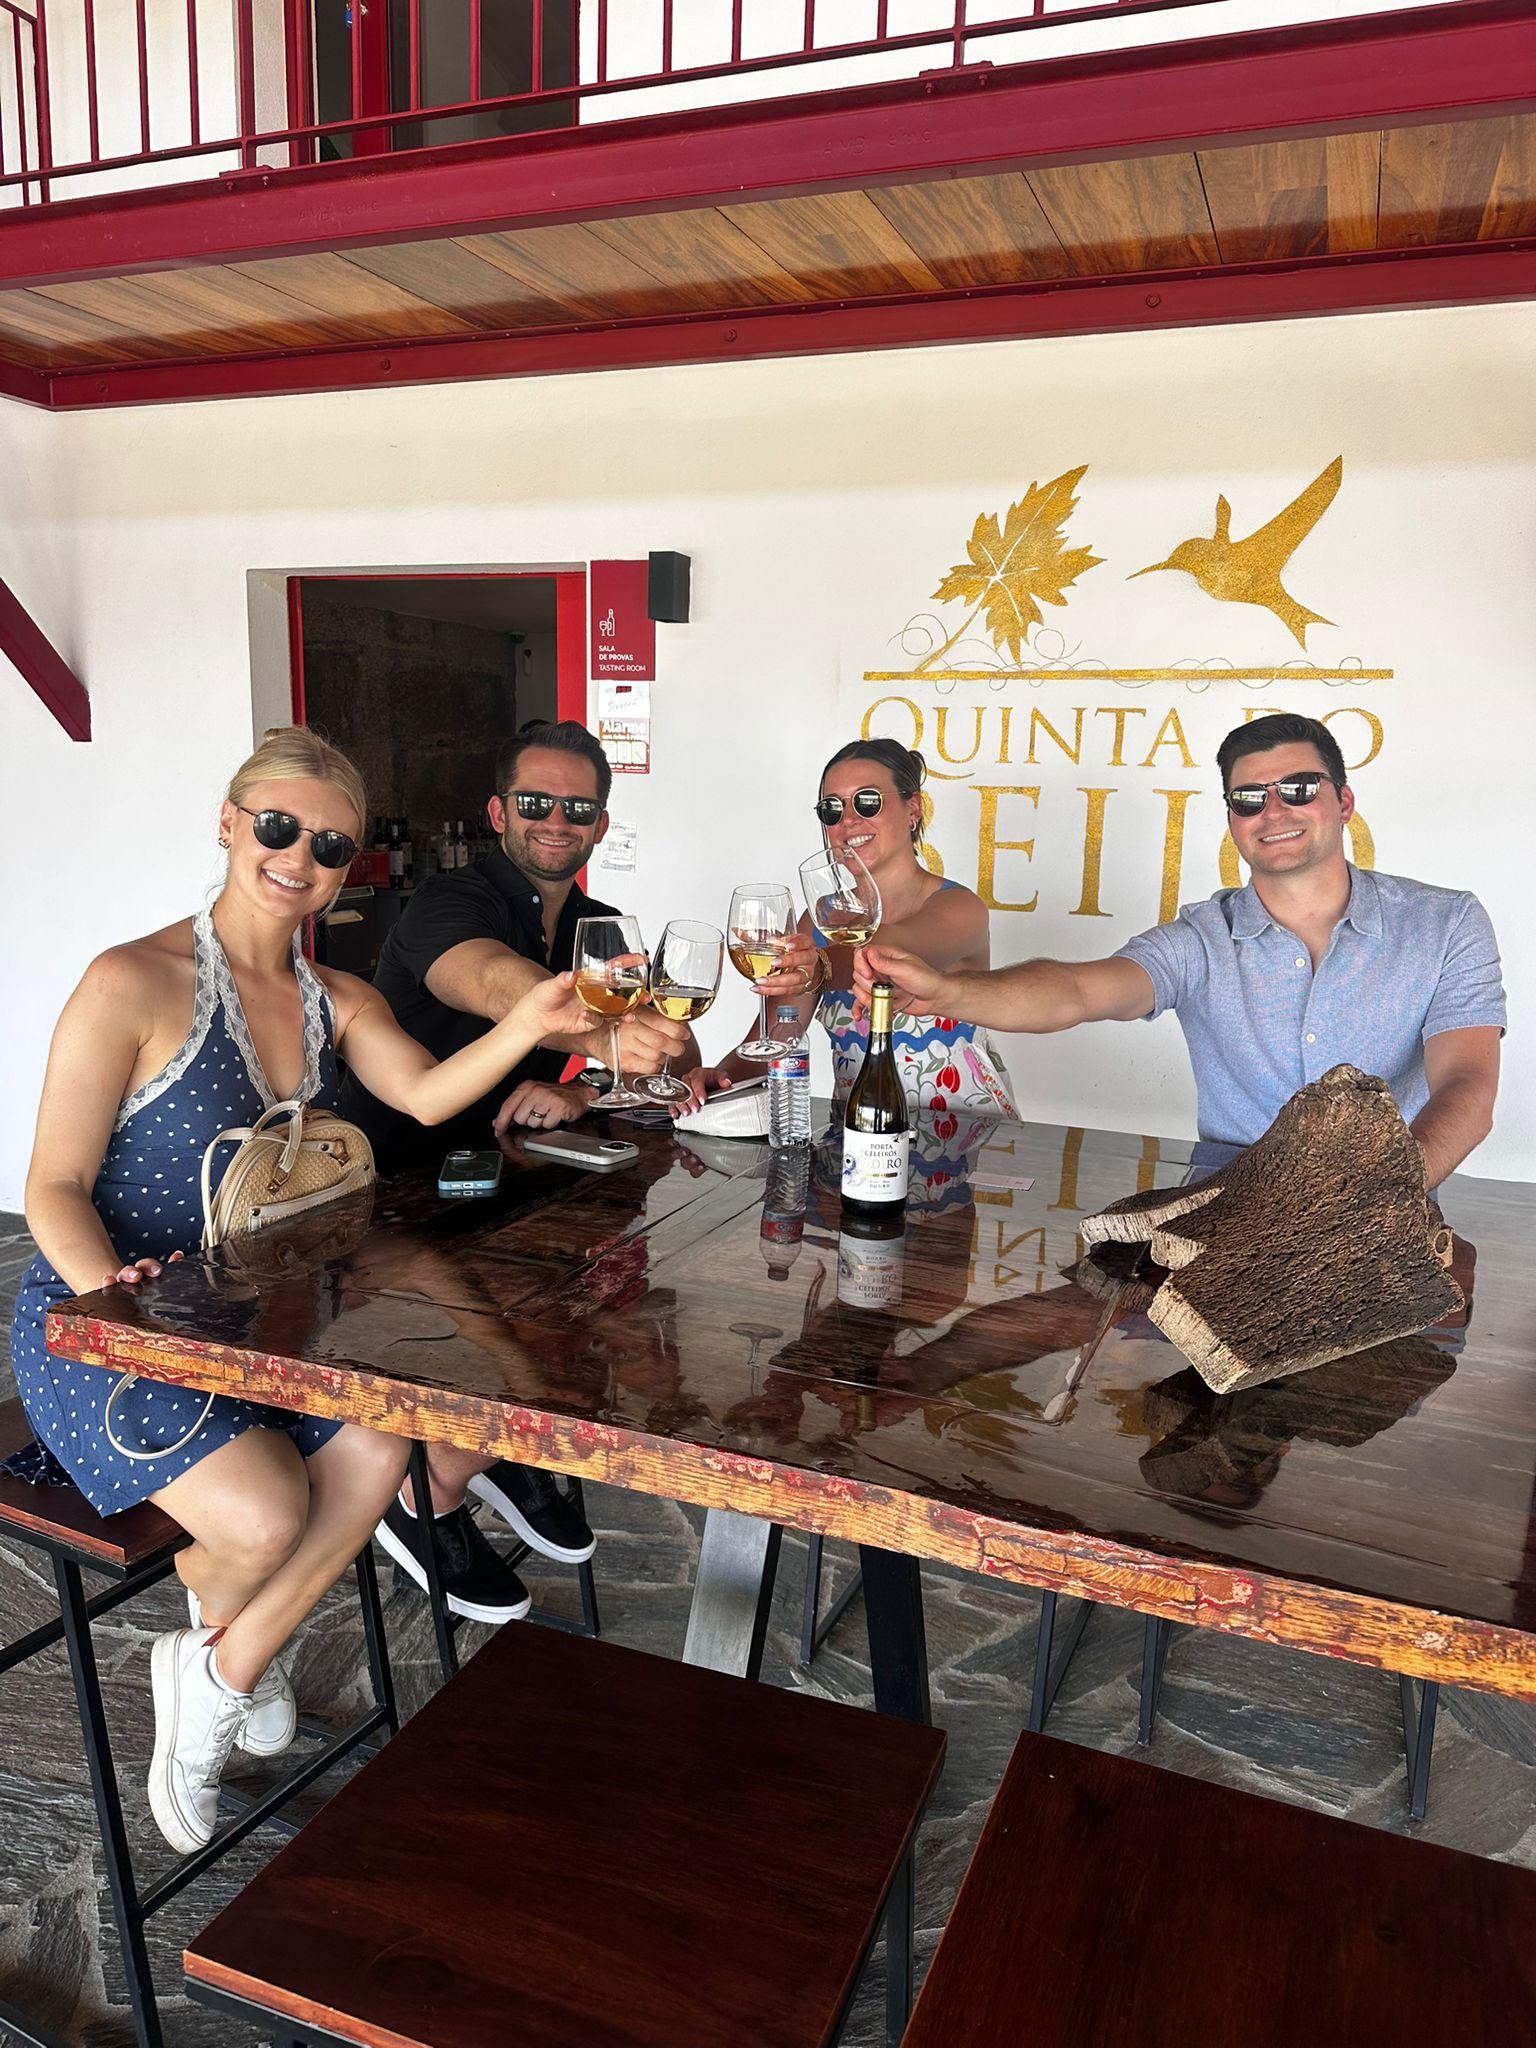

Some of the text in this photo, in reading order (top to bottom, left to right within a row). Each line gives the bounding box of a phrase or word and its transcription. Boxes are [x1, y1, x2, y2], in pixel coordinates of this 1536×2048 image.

[598, 653, 634, 661] DE PROVAS
[598, 664, 647, 672] TASTING ROOM
[861, 696, 1384, 781] QUINTA O
